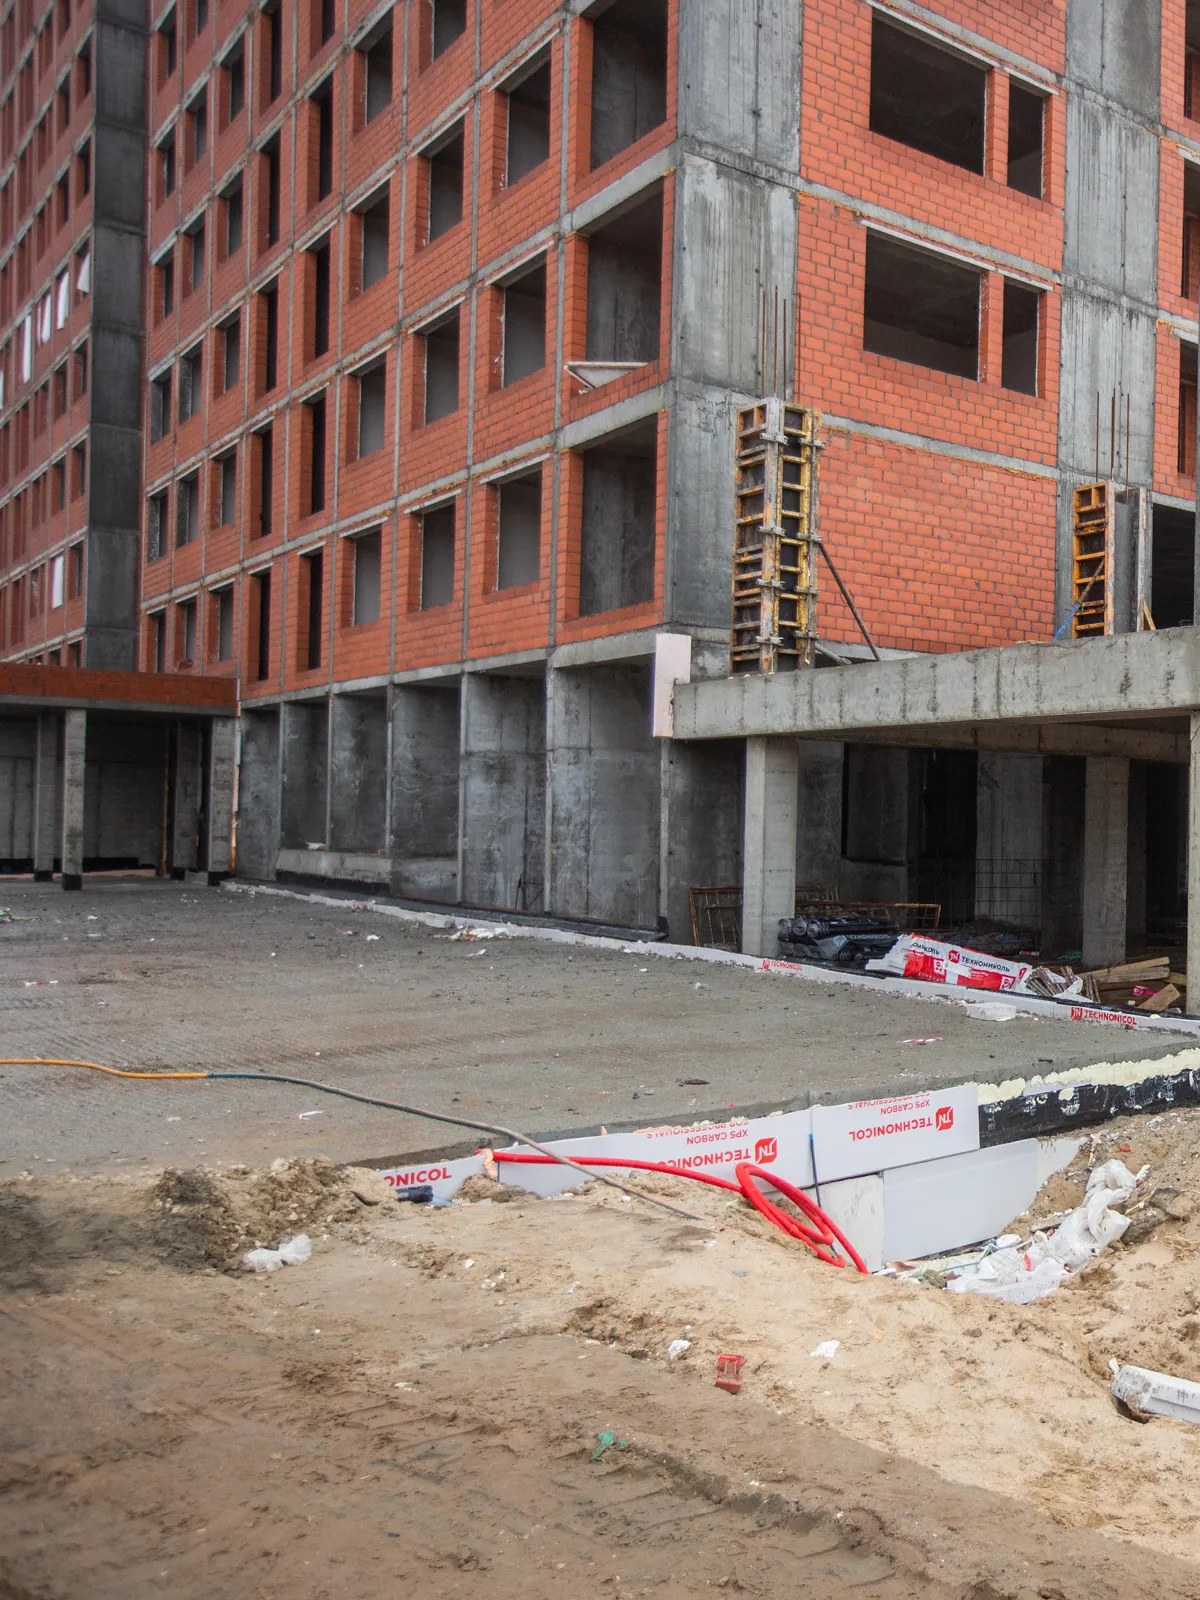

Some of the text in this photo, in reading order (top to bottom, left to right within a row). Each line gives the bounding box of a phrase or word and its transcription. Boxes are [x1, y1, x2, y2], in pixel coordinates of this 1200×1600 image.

[962, 956, 1010, 972] ТЕХНОНИКОЛЬ
[1084, 1009, 1137, 1025] TECHNONICOL
[880, 1100, 930, 1115] XPS CARBON
[849, 1116, 933, 1141] TECHNONICOL
[686, 1129, 748, 1145] XPS CARBON
[658, 1148, 751, 1169] TECHNONIC
[384, 1167, 452, 1187] ONICOL
